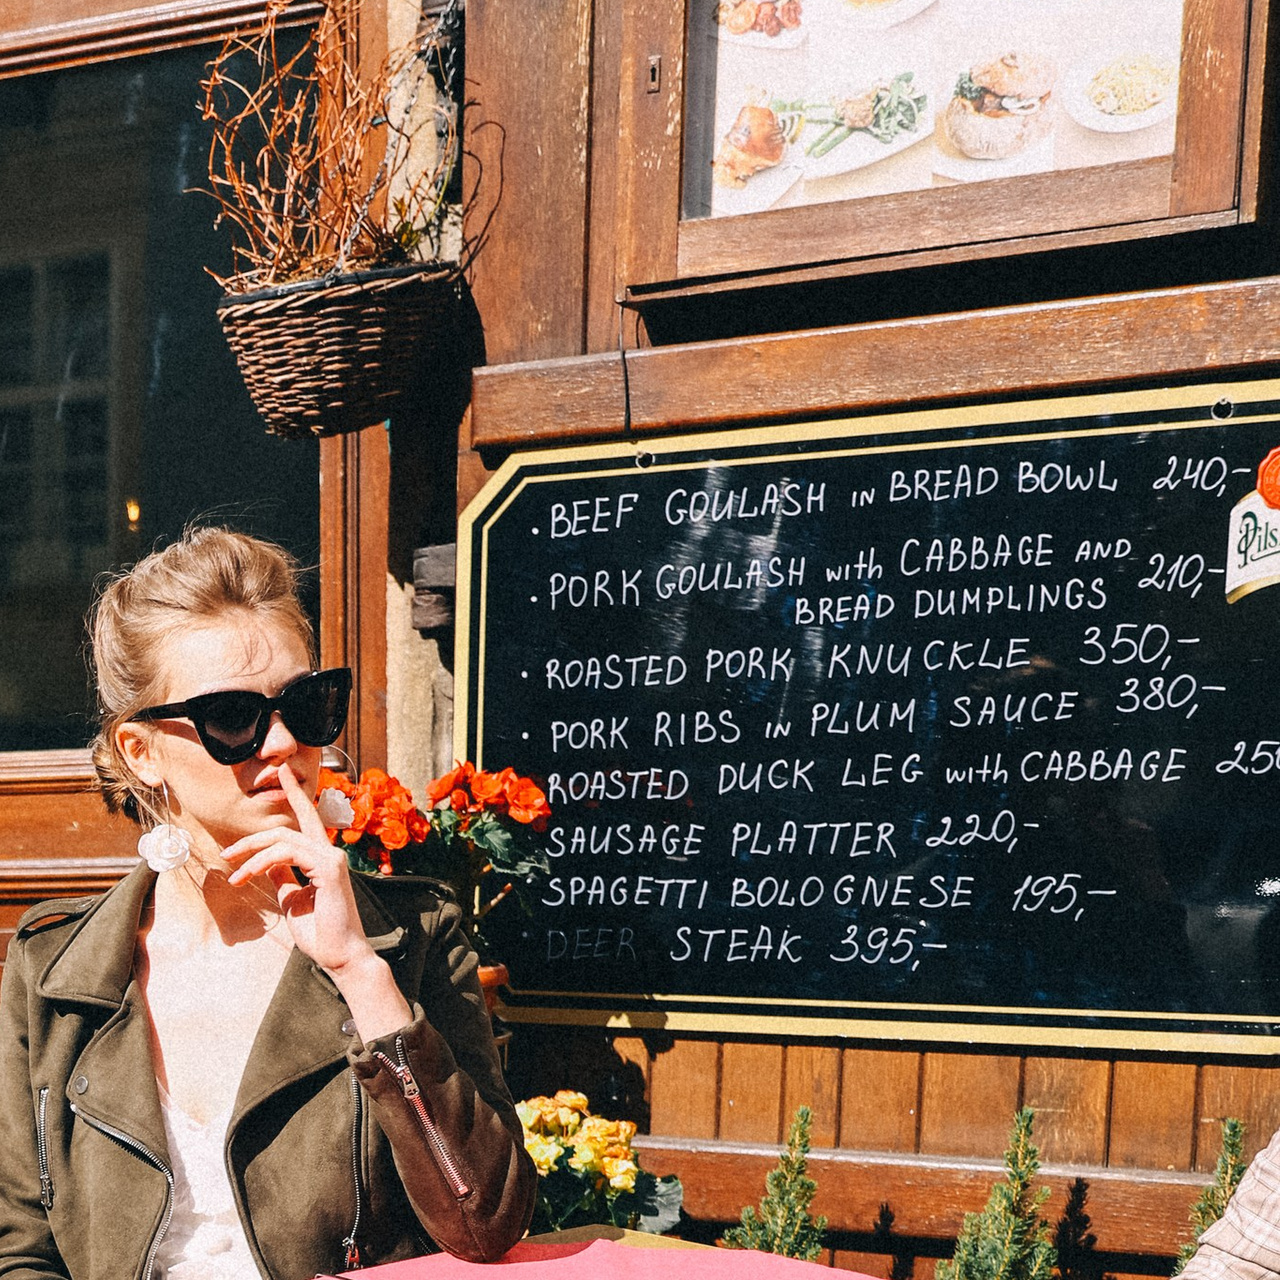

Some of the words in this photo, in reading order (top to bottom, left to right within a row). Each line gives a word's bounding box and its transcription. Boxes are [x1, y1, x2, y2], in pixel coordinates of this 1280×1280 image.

[550, 493, 639, 539] BEEF
[665, 482, 826, 526] GOULASH
[889, 464, 999, 503] BREAD
[1017, 459, 1118, 494] BOWL
[1237, 511, 1280, 569] Pils
[549, 569, 643, 611] PORK
[655, 556, 806, 600] GOULASH
[825, 546, 883, 582] with
[900, 533, 1054, 576] CABBAGE
[1074, 538, 1132, 563] AND
[795, 593, 895, 625] BREAD
[914, 577, 1107, 619] DUMPLINGS
[545, 654, 687, 690] ROASTED
[705, 646, 795, 683] PORK
[827, 638, 1031, 679] KNUCKLE
[550, 716, 629, 753] PORK
[654, 709, 741, 747] RIBS
[810, 698, 916, 737] PLUM
[949, 691, 1079, 728] SAUCE
[547, 767, 689, 805] ROASTED
[718, 758, 815, 795] DUCK
[841, 753, 924, 787] LEG
[945, 752, 1008, 784] with
[1020, 748, 1187, 783] CABBAGE
[545, 823, 706, 861] SAUSAGE
[731, 820, 897, 858] PLATTER
[541, 875, 709, 909] SPAGETTI
[730, 874, 975, 908] BOLOGNESE
[547, 928, 637, 962] DEER
[669, 924, 802, 963] STEAK
